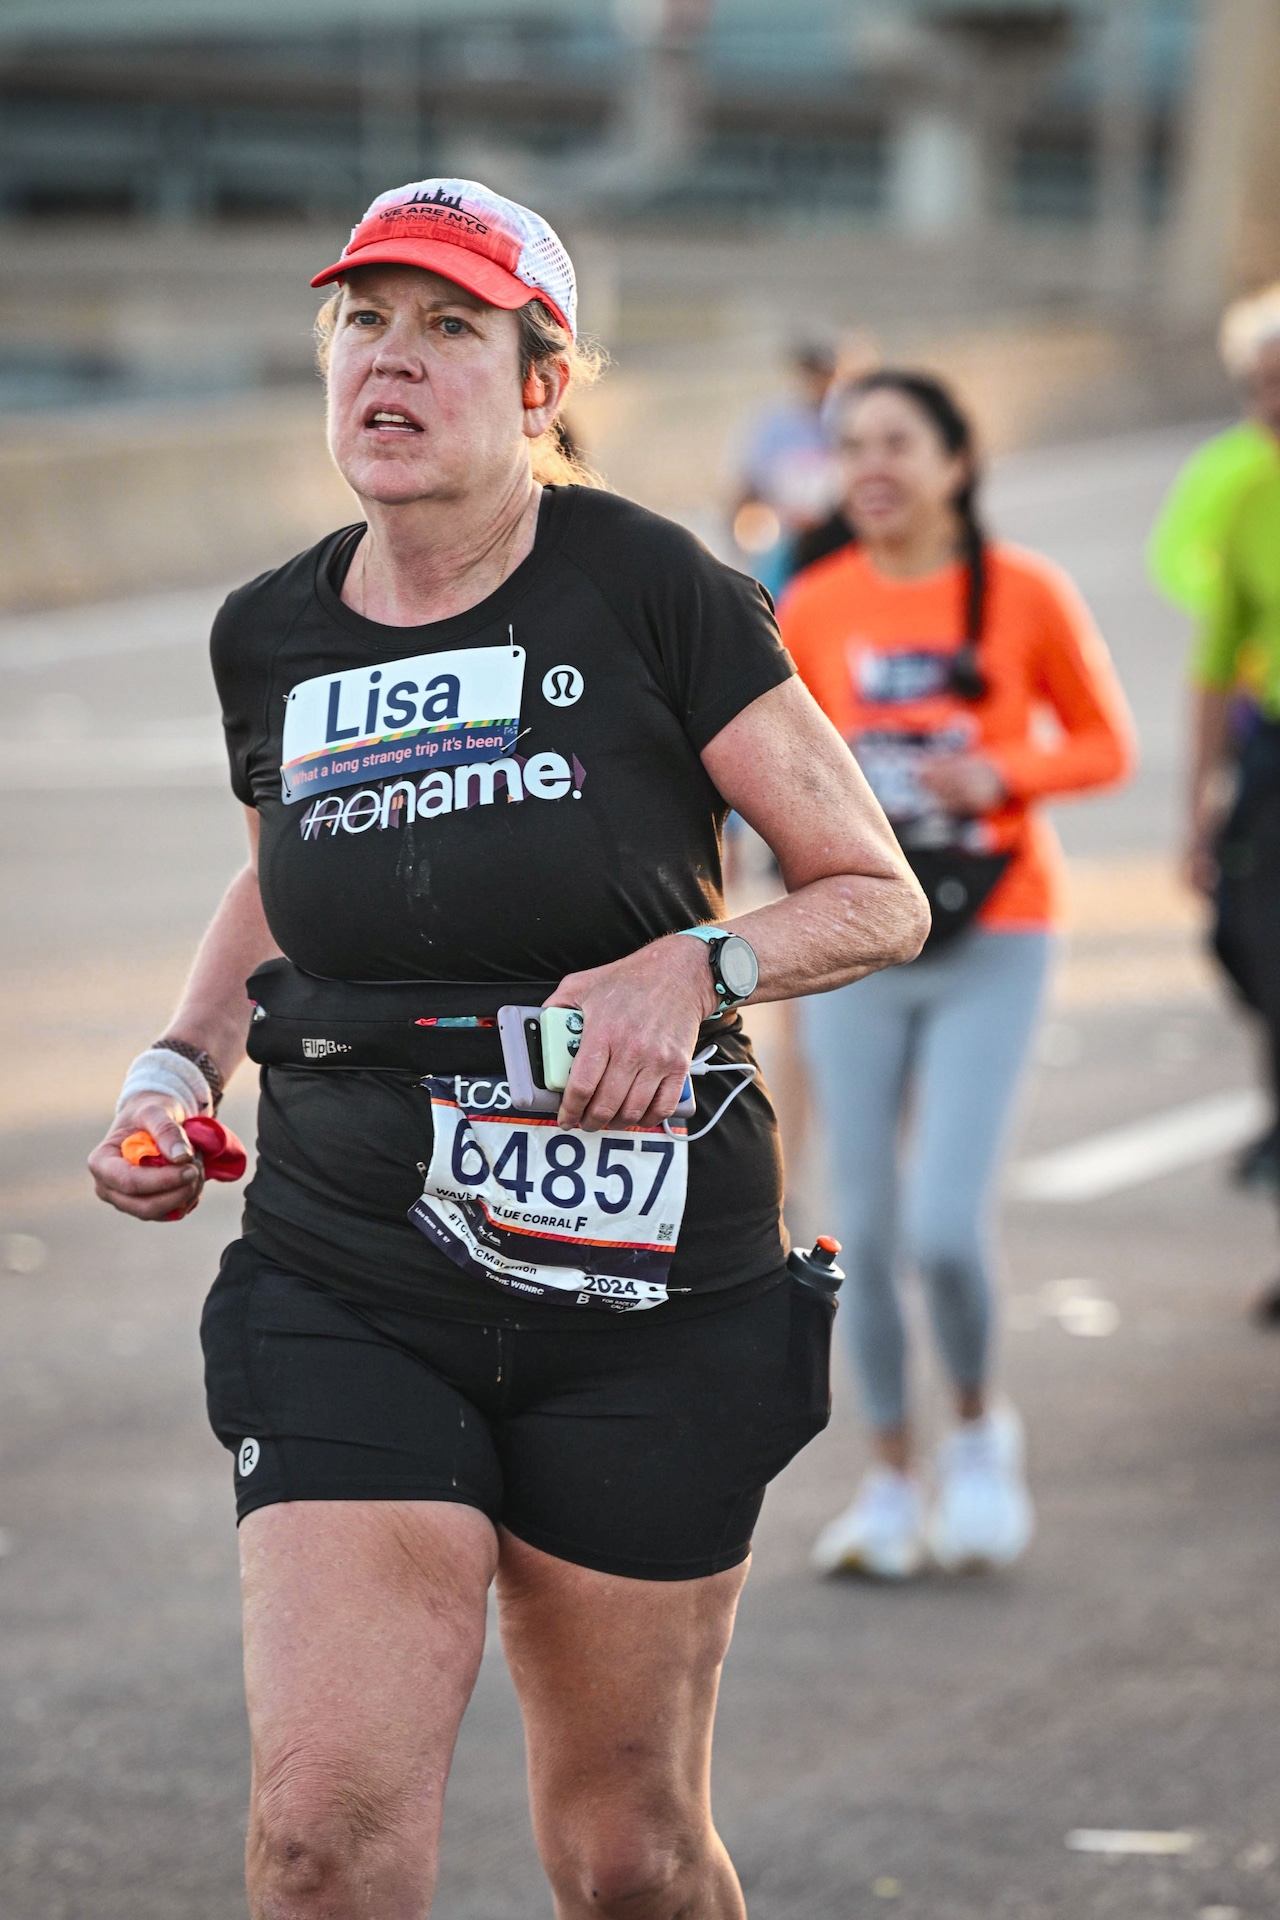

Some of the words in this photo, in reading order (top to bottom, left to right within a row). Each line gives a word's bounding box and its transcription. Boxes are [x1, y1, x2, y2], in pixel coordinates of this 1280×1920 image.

[379, 208, 402, 220] WE
[407, 206, 444, 217] ARE
[449, 212, 490, 235] NYC
[385, 214, 439, 224] RUNNING
[325, 670, 461, 744] Lisa
[292, 765, 319, 786] What
[321, 767, 328, 777] a
[331, 759, 359, 774] long
[362, 748, 411, 767] strange
[415, 743, 439, 757] trip
[442, 738, 462, 751] it's
[466, 736, 503, 750] been
[454, 1075, 511, 1109] tcs
[451, 1118, 675, 1217] 64857
[436, 1188, 472, 1201] WAVE
[522, 1213, 573, 1229] CORRAL
[574, 1216, 588, 1232] F
[511, 1280, 545, 1295] WRNRC
[576, 1293, 590, 1304] B
[583, 1276, 638, 1295] 2024
